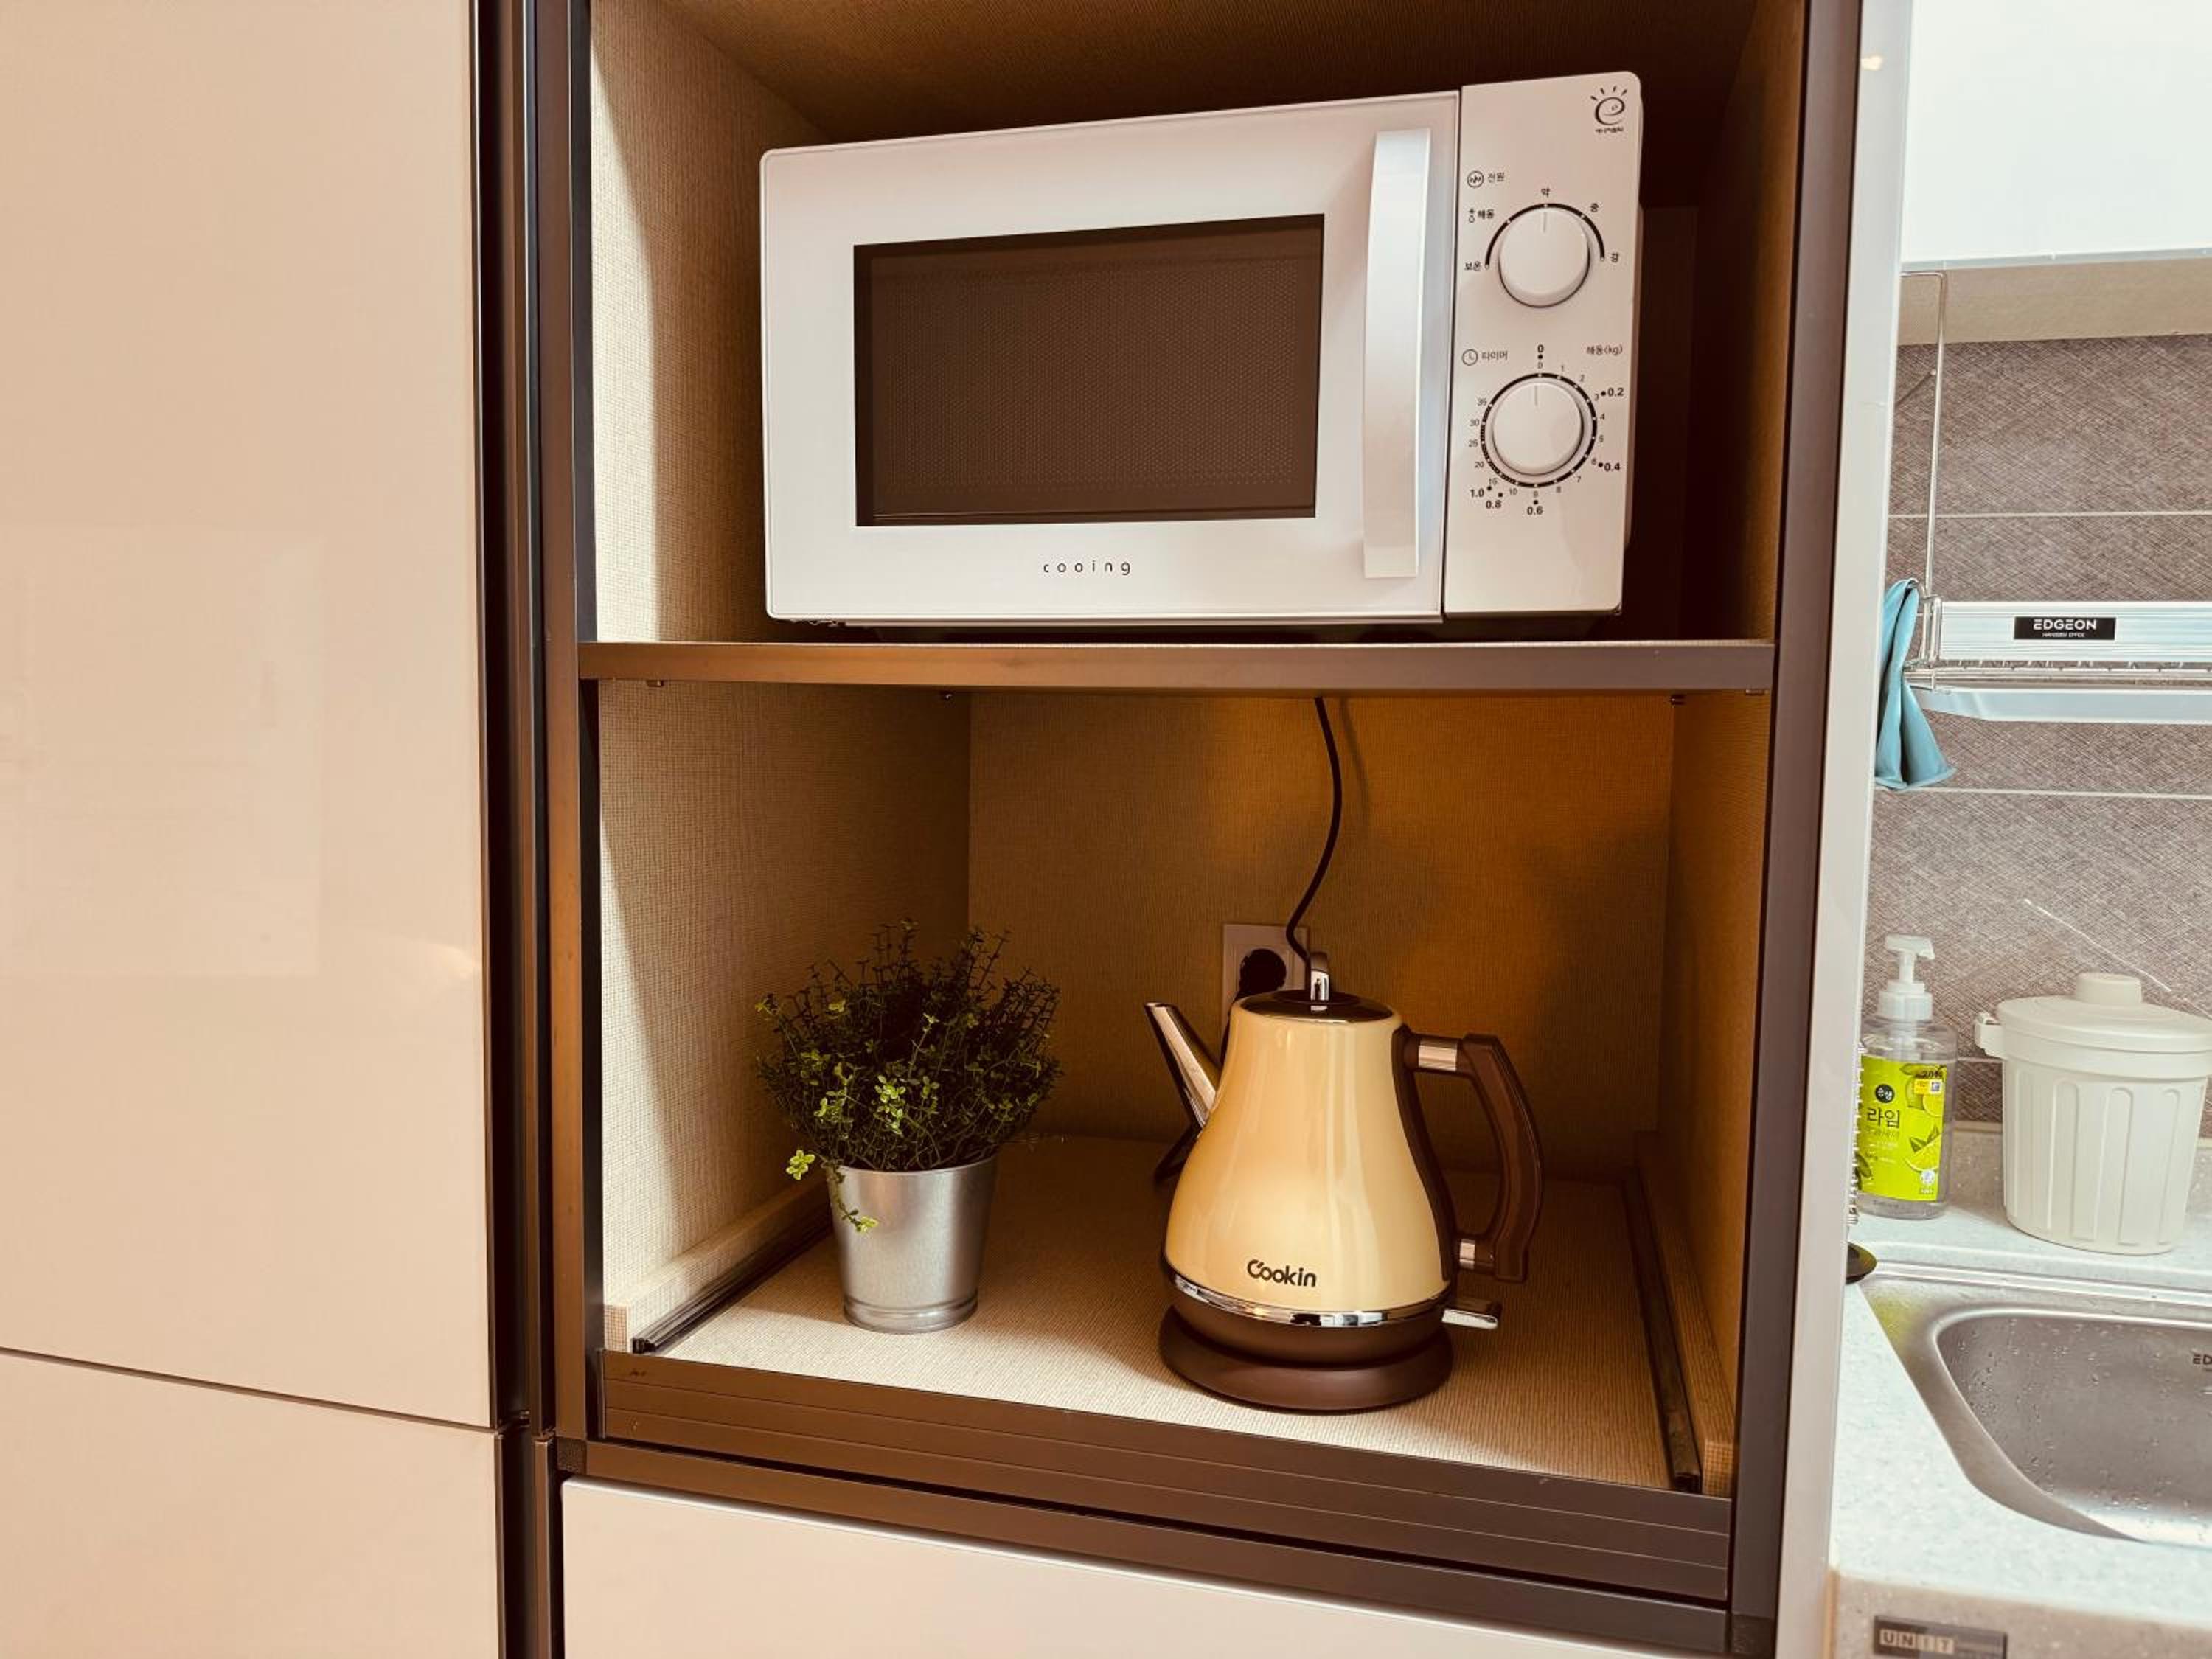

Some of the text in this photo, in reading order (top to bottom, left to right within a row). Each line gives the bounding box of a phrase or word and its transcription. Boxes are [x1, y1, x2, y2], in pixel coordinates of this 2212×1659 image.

[1537, 344, 1545, 353] 0
[1607, 387, 1624, 397] 0.2
[1475, 461, 1484, 469] 20
[1604, 462, 1621, 472] 0.4
[1470, 488, 1484, 498] 1.0
[1486, 499, 1502, 509] 0.8
[1527, 506, 1543, 515] 0.6
[1043, 560, 1130, 576] cooing
[2033, 619, 2097, 630] EDGEON
[1867, 1107, 1900, 1128] 라임
[1247, 1259, 1316, 1287] Cookin
[1881, 1630, 1952, 1654] UNIT
